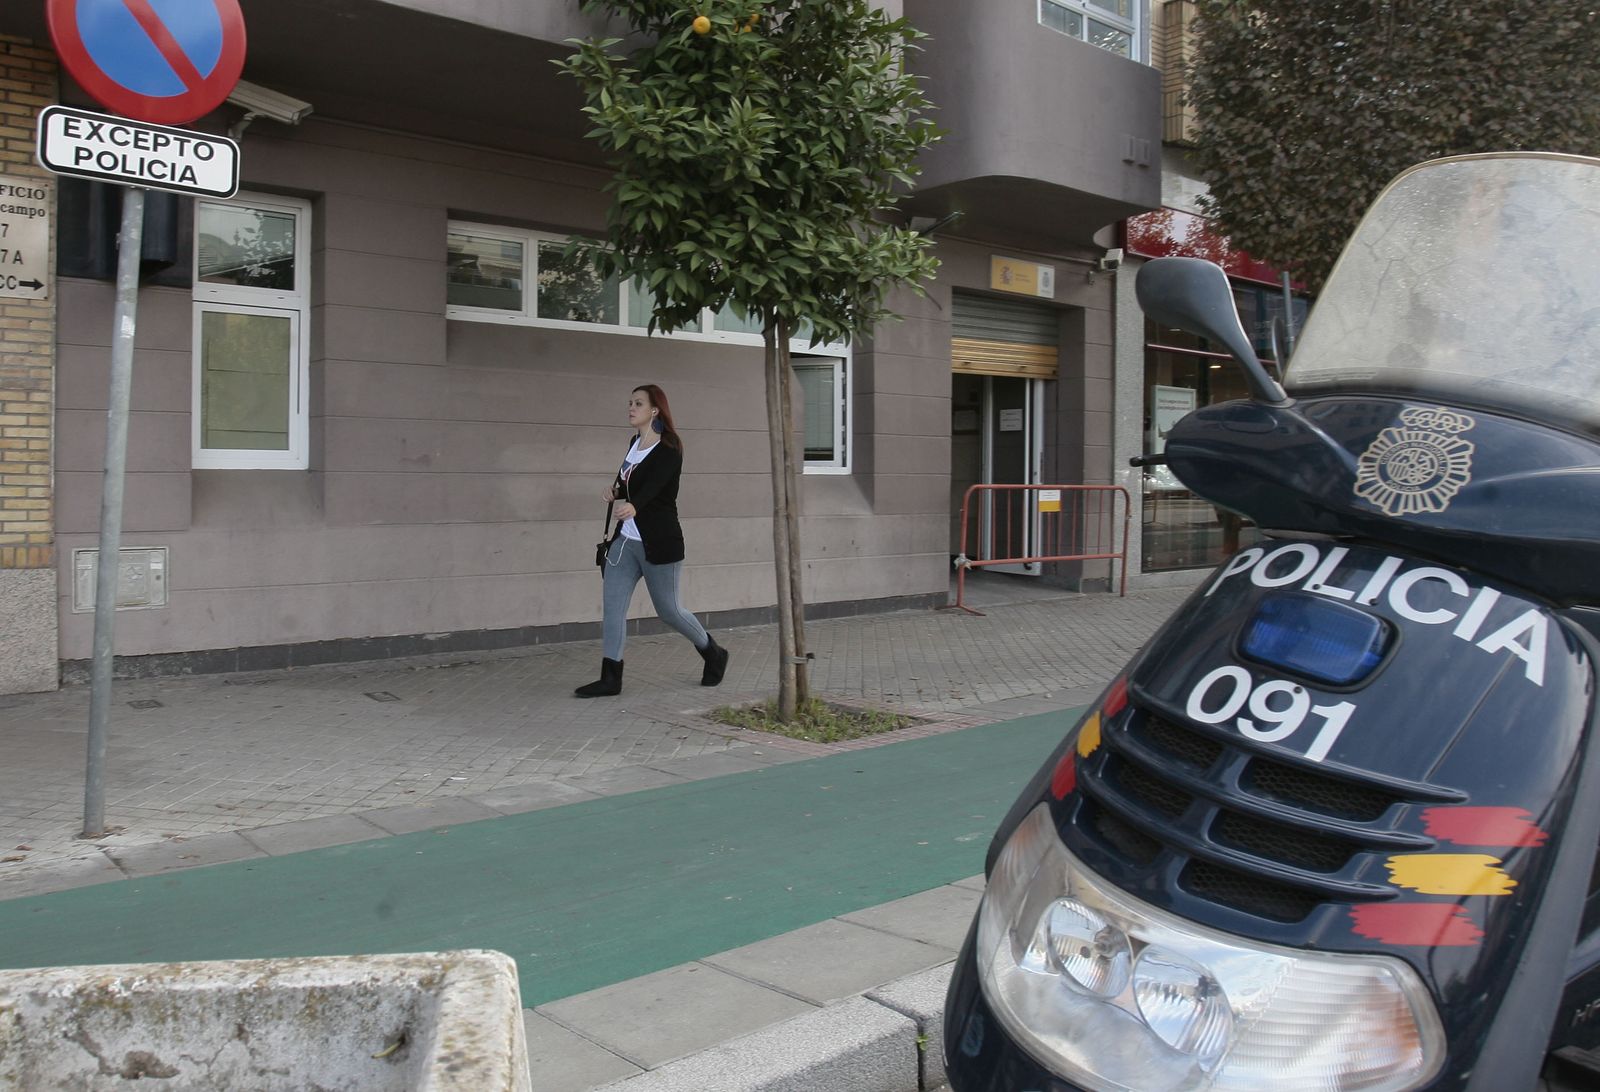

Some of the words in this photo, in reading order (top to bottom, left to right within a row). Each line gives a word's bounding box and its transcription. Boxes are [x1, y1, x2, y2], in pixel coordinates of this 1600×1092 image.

[63, 117, 215, 162] EXCEPTO
[74, 146, 199, 186] POLICIA
[0, 203, 46, 219] campo
[1, 223, 9, 238] 7
[12, 250, 24, 265] A
[1205, 543, 1549, 687] POLICIA
[1186, 665, 1357, 763] 091
